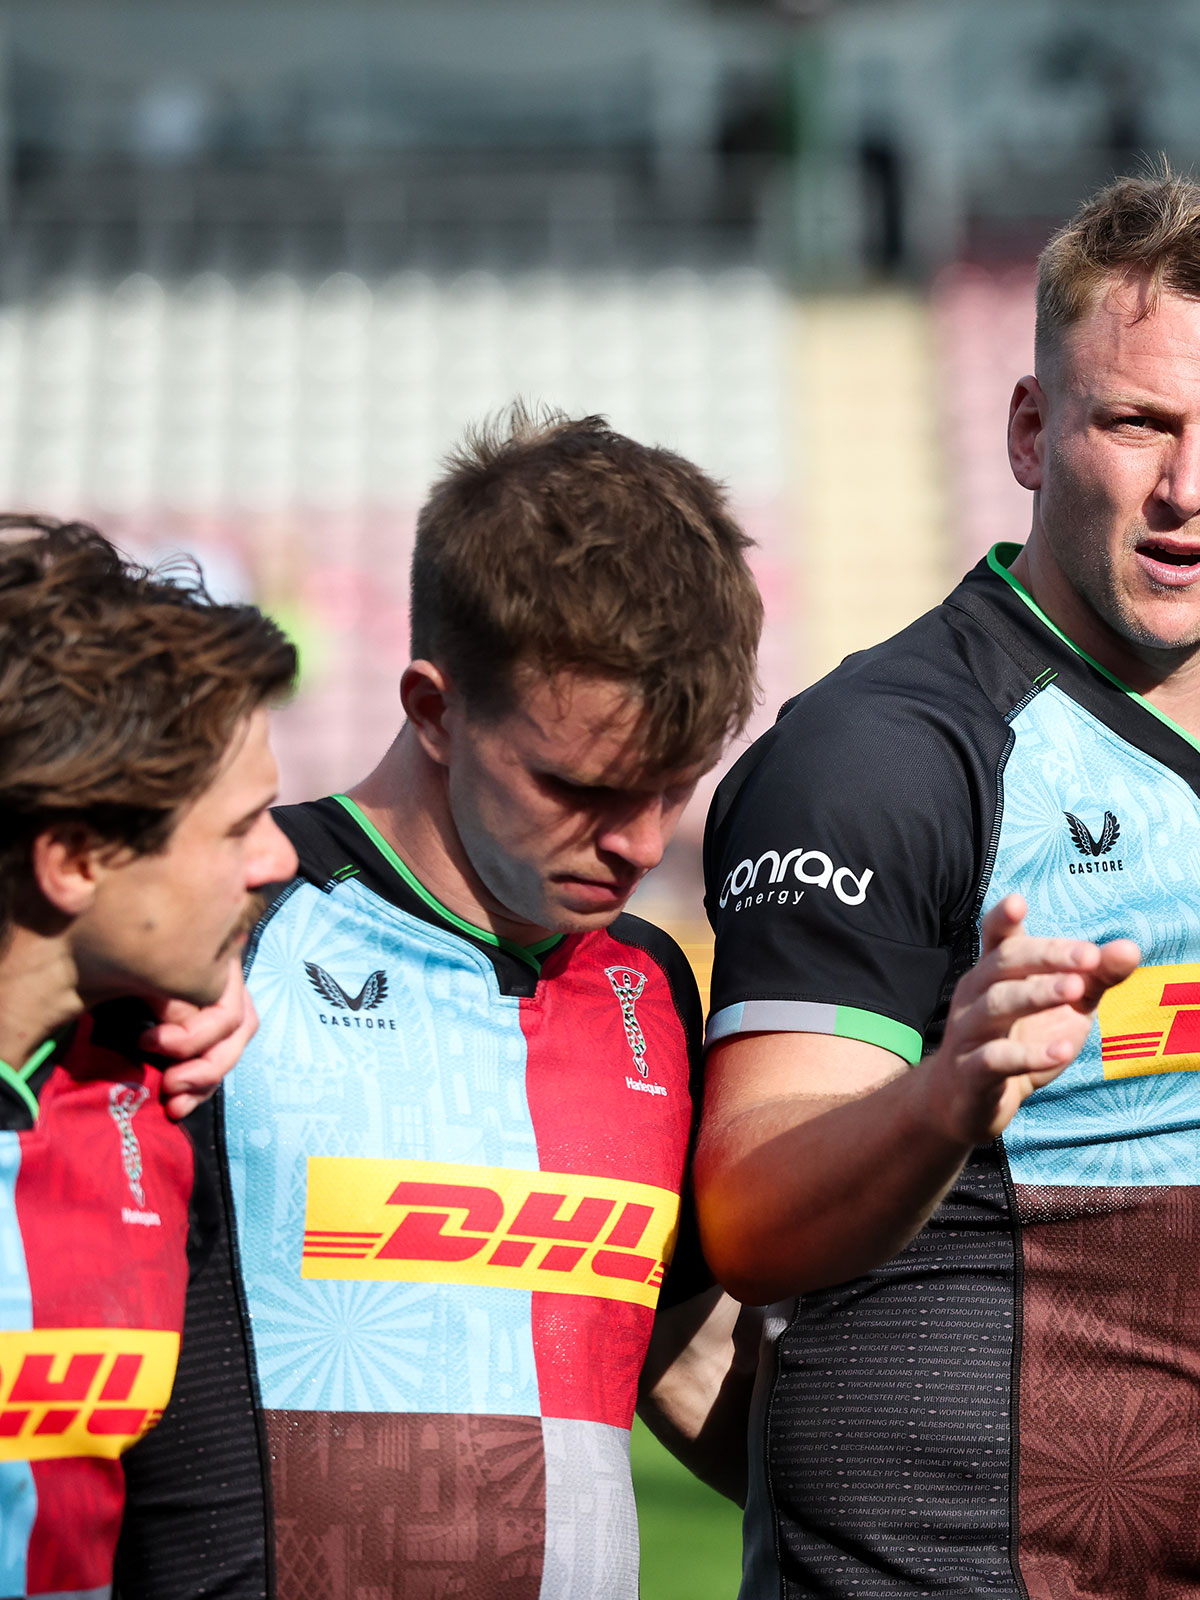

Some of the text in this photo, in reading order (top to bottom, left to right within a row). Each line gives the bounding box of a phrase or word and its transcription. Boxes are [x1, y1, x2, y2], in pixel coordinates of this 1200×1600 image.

[1069, 860, 1123, 874] CASTORE
[719, 848, 874, 908] conrad
[735, 889, 806, 912] energy
[319, 1014, 396, 1030] CASTORE
[625, 1076, 667, 1096] Harlequins
[374, 1181, 657, 1284] DHL
[937, 1241, 996, 1251] CATERHAMIANS
[998, 1240, 1013, 1248] RFC
[946, 1284, 1011, 1293] WIMBLEDONIANS
[946, 1296, 997, 1304] PETERSFIELD
[930, 1308, 983, 1316] PORTSMOUTH
[984, 1309, 1001, 1317] RFC
[852, 1320, 901, 1328] PORTSMOUTH
[851, 1332, 901, 1340] PULBOROUGH
[890, 1344, 906, 1352] RFC
[950, 1345, 967, 1353] RFC
[917, 1357, 962, 1365] TONBRIDGE
[962, 1359, 1001, 1367] JUDDIANS
[943, 1370, 995, 1379] TWICKENHAM
[925, 1383, 976, 1391] WINCHESTER
[0, 1354, 149, 1437] HL
[924, 1395, 970, 1403] WEYBRIDGE
[970, 1397, 1006, 1405] VANDALS
[889, 1419, 905, 1427] RFC
[918, 1421, 965, 1429] ALRESFORD
[966, 1422, 983, 1430] RFC
[920, 1433, 977, 1441] BECCEHAMIAN
[978, 1435, 995, 1443] RFC
[925, 1447, 966, 1455] BRIGHTON
[886, 1457, 902, 1465] RFC
[953, 1460, 969, 1468] RFC
[847, 1469, 884, 1477] BROMLEY
[885, 1482, 901, 1490] RFC
[914, 1483, 973, 1491] BOURNEMOUTH
[839, 1495, 897, 1503] BOURNEMOUTH
[926, 1496, 970, 1504] CRANLEIGH
[847, 1507, 890, 1515] CRANLEIGH
[878, 1520, 903, 1528] HEATH
[904, 1521, 920, 1529] RFC
[933, 1521, 979, 1529] HEATHFIELD
[980, 1521, 997, 1529] AND
[959, 1557, 1002, 1565] WEYBRIDGE
[857, 1590, 903, 1598] WIMBLEDON
[931, 1588, 974, 1597] BATTERSEA
